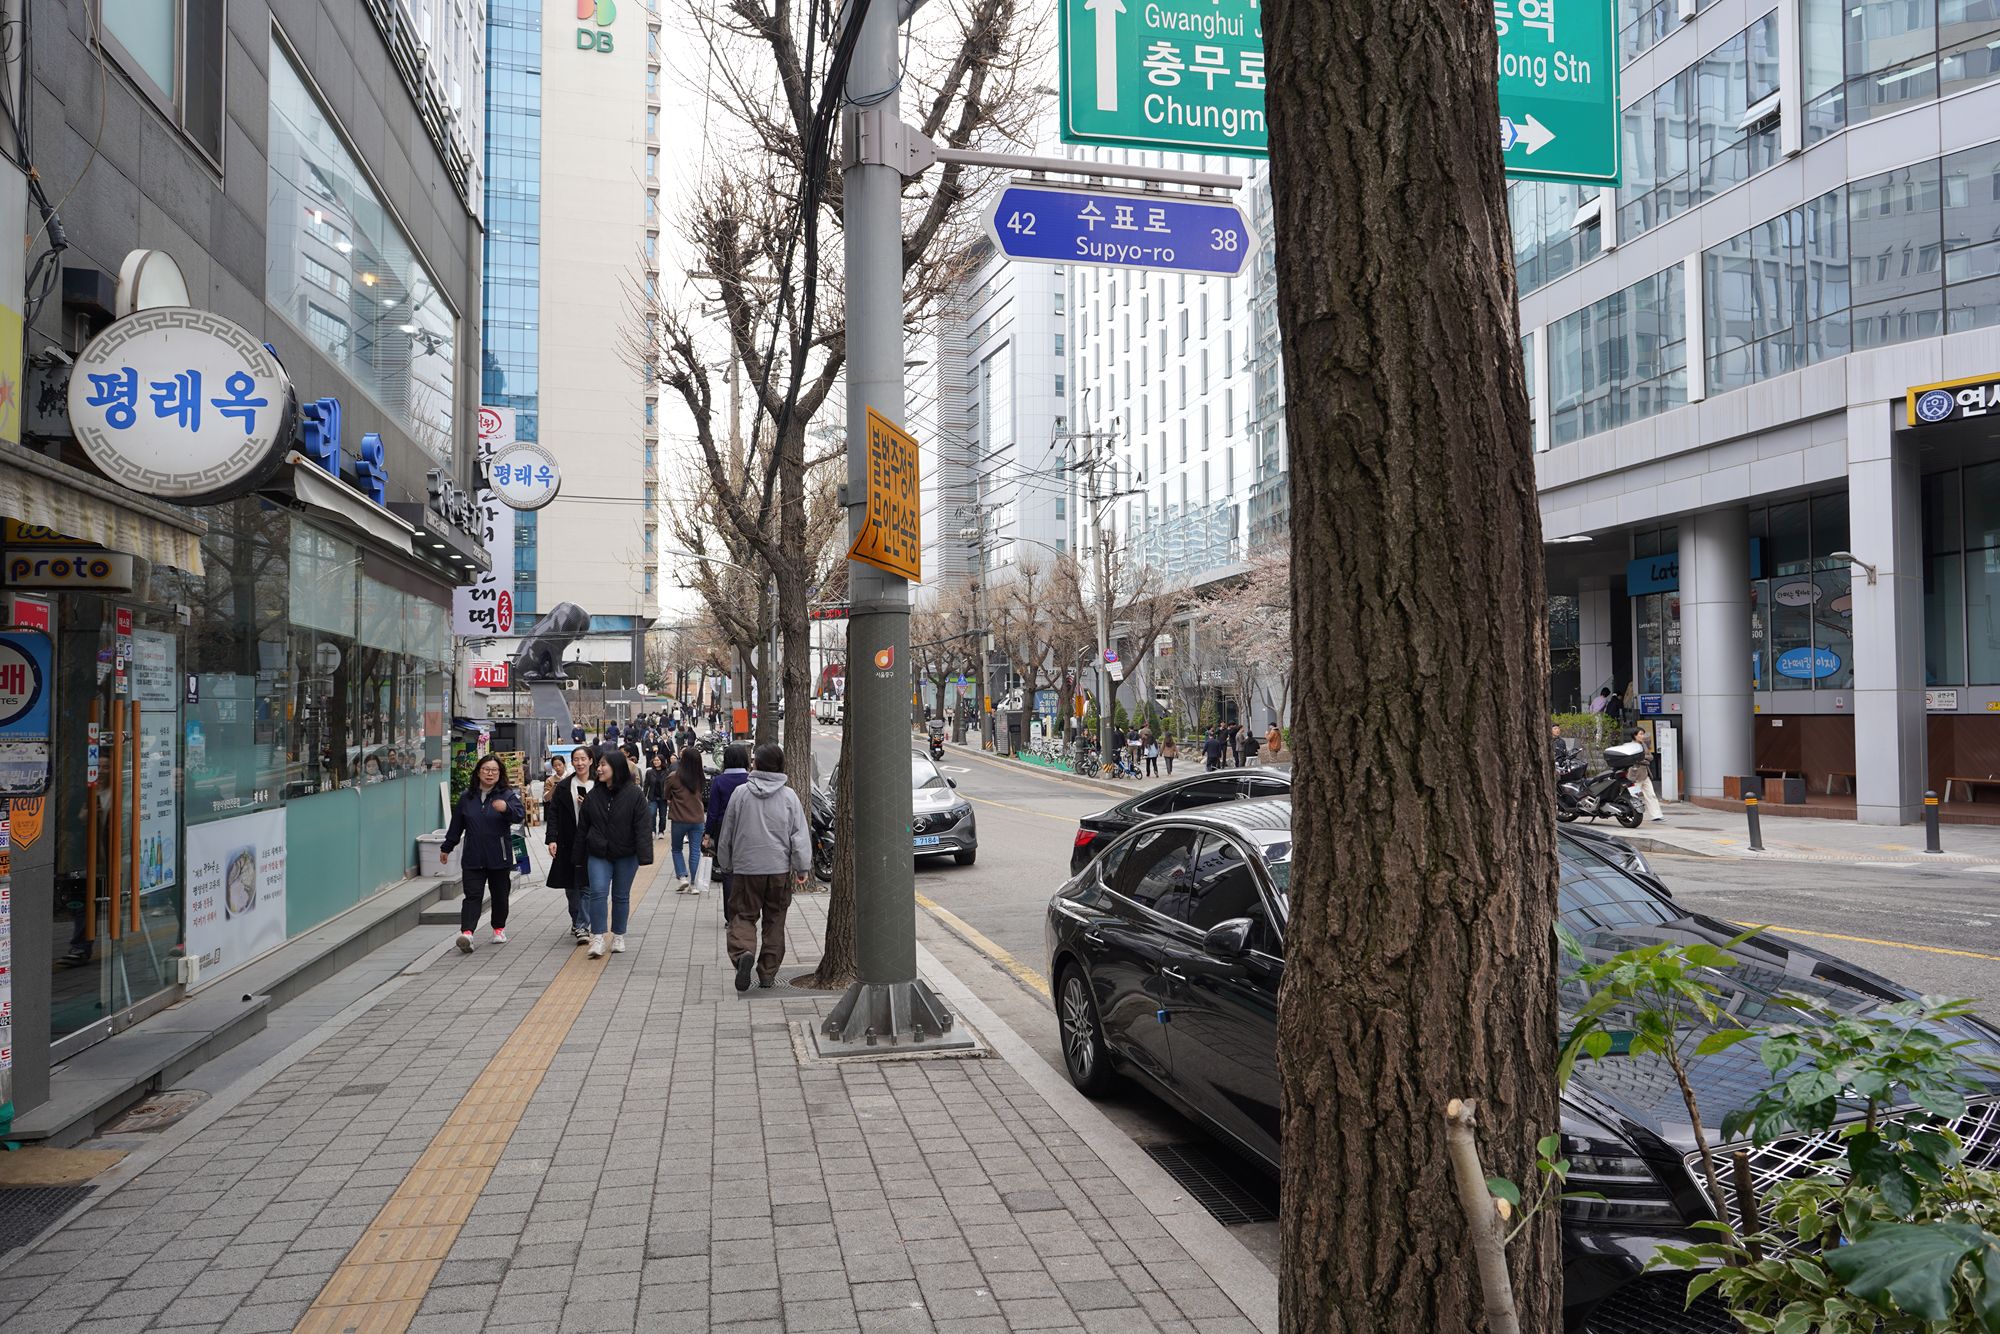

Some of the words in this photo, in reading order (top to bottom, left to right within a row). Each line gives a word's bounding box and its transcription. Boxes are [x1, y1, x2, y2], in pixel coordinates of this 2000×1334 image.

[1145, 3, 1244, 39] Gwanghui
[577, 28, 614, 53] DB
[1143, 41, 1266, 90] 충무로
[1554, 50, 1591, 84] Stn
[1007, 211, 1036, 235] 42
[1077, 201, 1172, 234] 수표로
[1210, 228, 1238, 252] 38
[1076, 236, 1175, 263] Supyo-ro
[86, 366, 269, 436] 평래옥
[1956, 384, 2000, 418] 연
[302, 397, 389, 508] 래옥
[872, 425, 916, 505] 불법주정차
[493, 463, 555, 489] 평래옥
[872, 490, 917, 564] 무인단속중
[11, 557, 109, 582] proto
[1651, 561, 1679, 581] Lat
[468, 571, 497, 633] 대떡
[500, 595, 510, 627] 24시
[12, 797, 43, 817] Kelly
